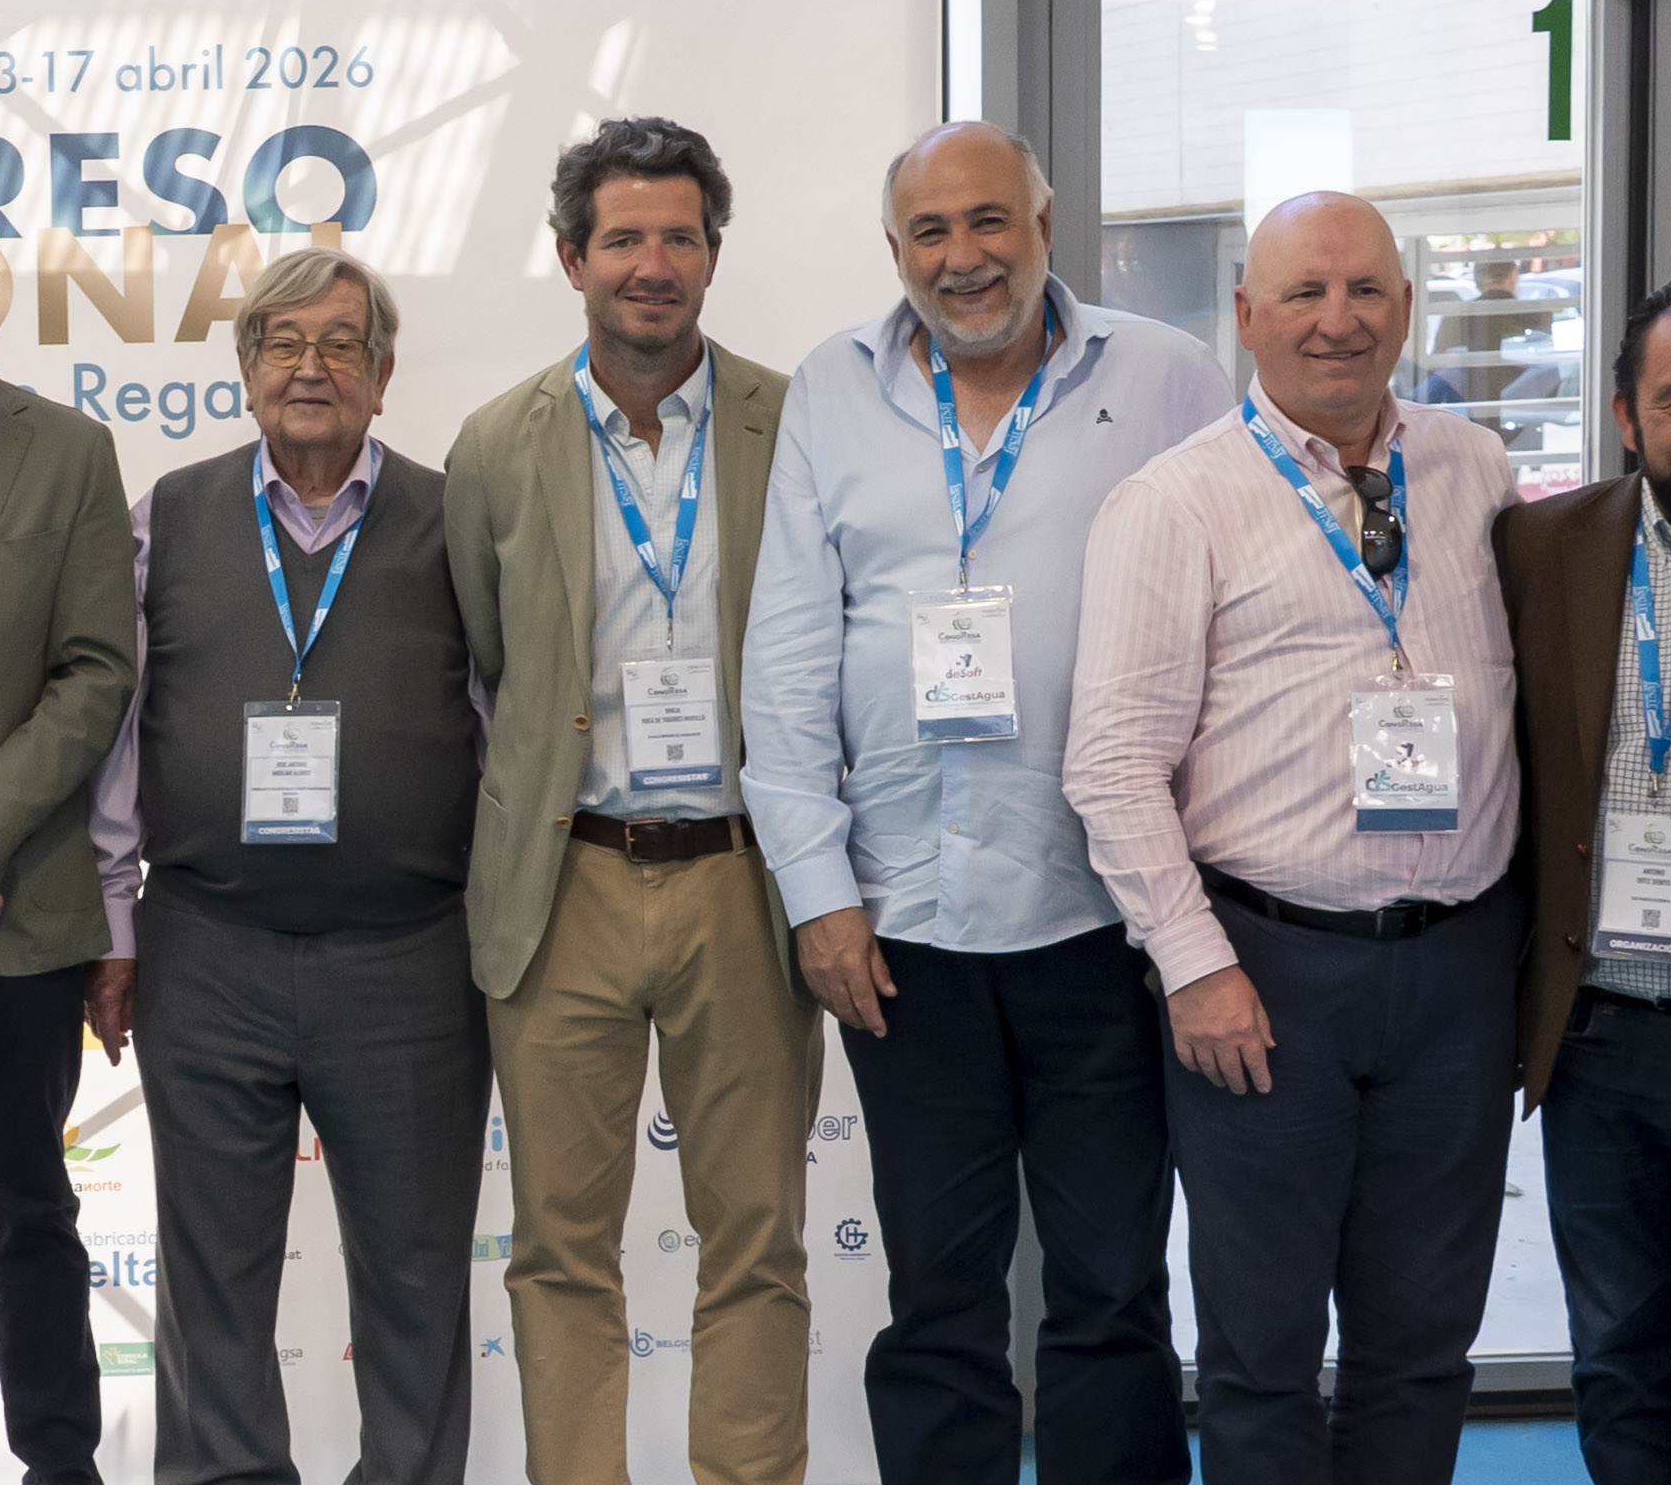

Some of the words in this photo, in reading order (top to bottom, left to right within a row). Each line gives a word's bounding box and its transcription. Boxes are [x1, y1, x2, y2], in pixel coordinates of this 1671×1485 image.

[115, 45, 223, 92] abril
[245, 45, 374, 90] 2026
[73, 363, 259, 440] Rega
